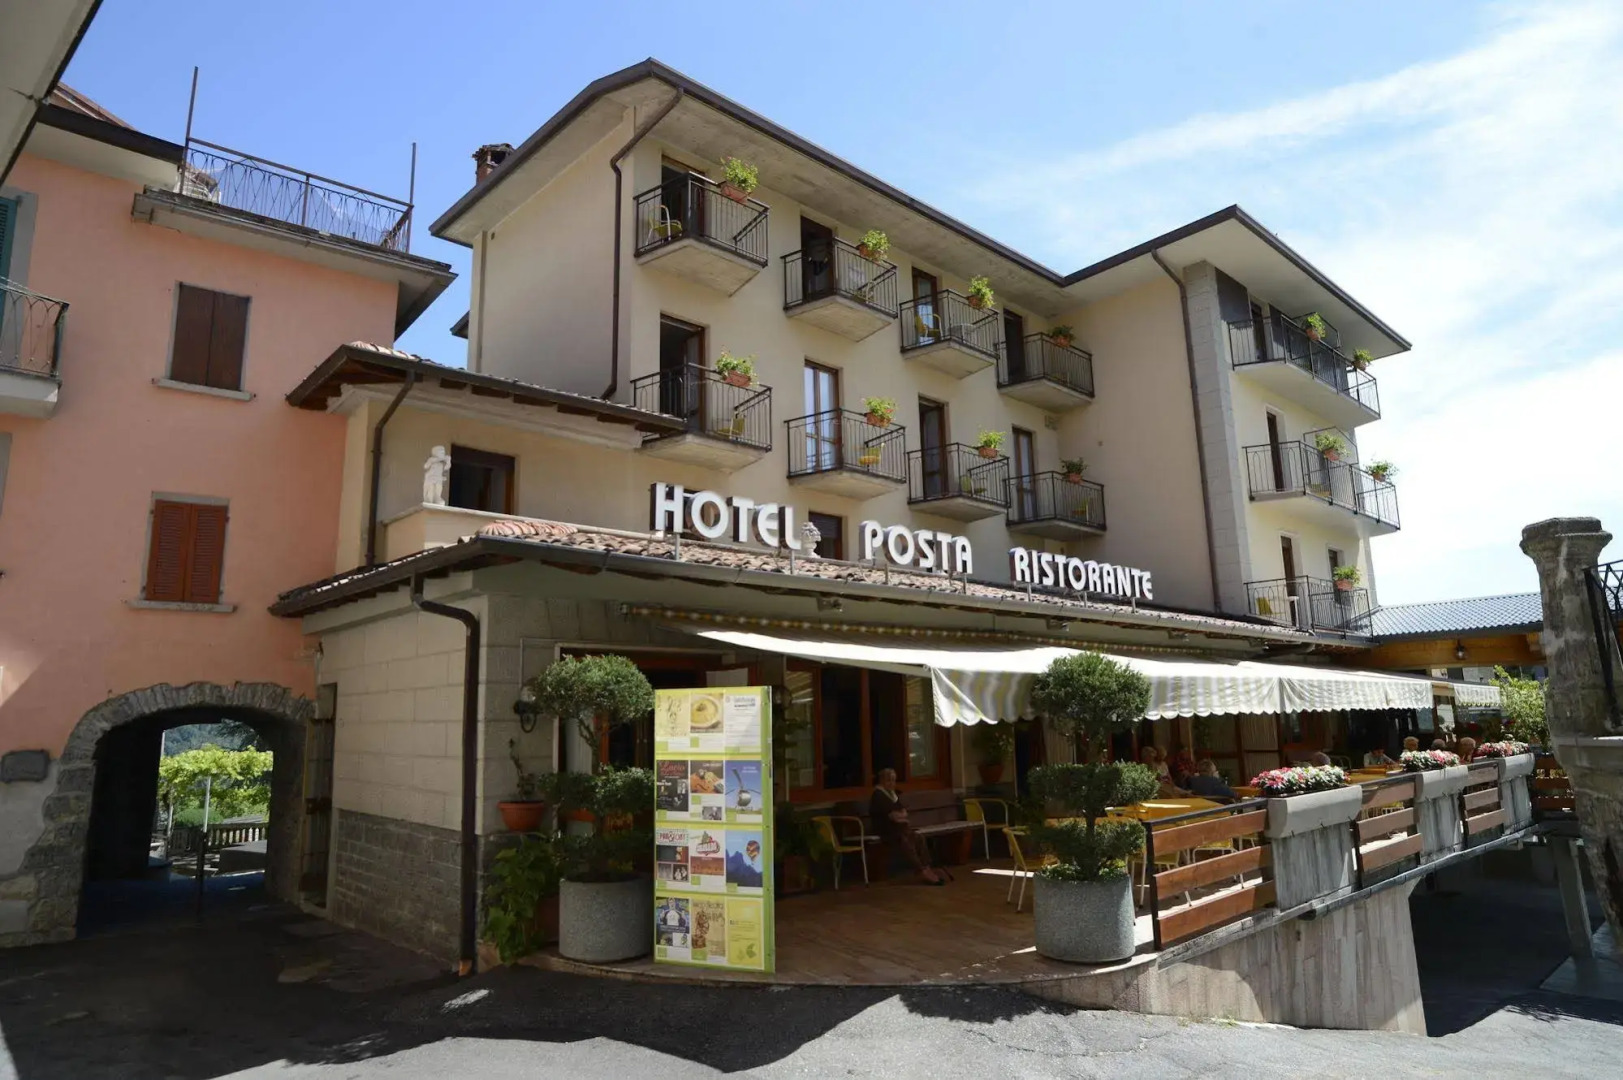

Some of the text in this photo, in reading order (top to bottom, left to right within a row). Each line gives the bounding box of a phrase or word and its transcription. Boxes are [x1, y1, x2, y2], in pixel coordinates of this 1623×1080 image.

[651, 482, 1153, 600] HOTEL POSTA RISTORANTE
